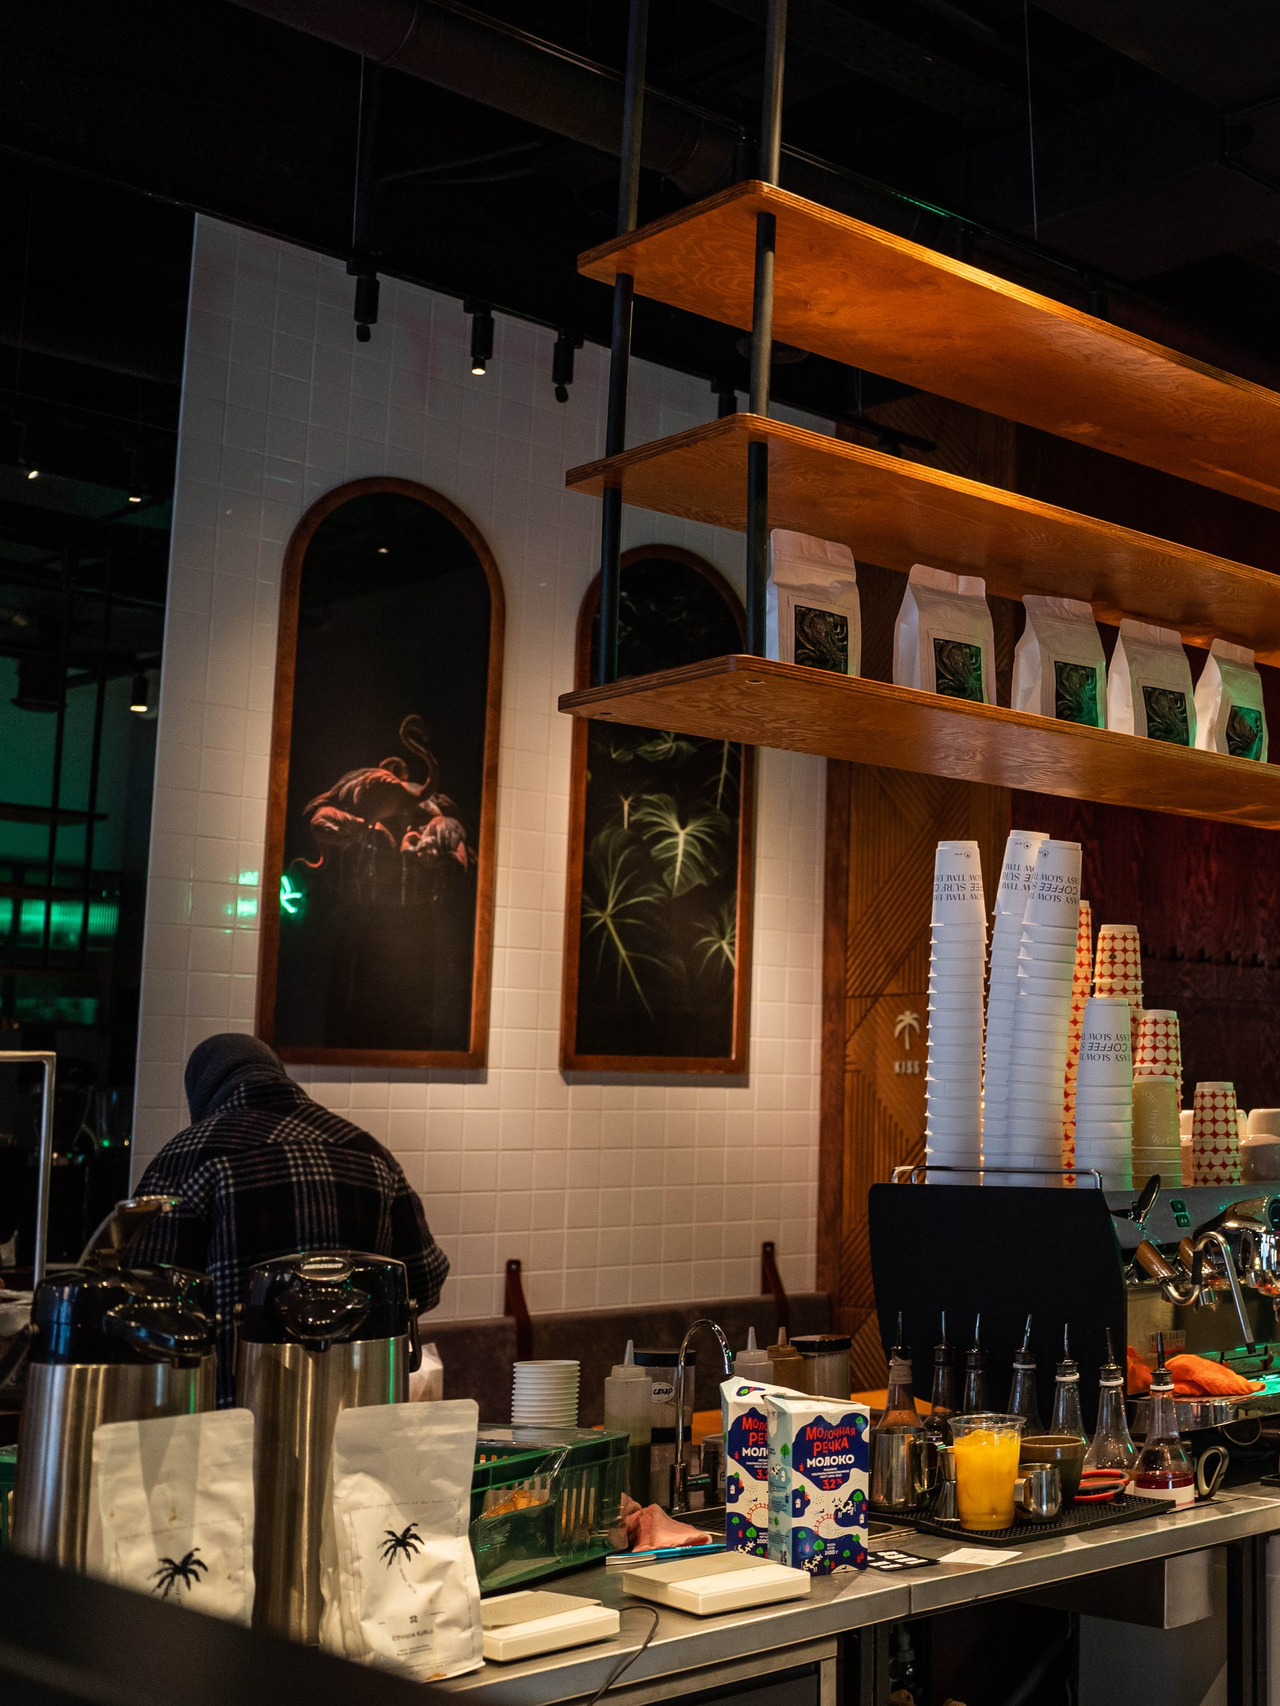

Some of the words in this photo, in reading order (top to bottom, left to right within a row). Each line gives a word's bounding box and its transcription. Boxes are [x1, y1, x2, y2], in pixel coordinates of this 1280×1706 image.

[1040, 873, 1064, 883] SLOW
[941, 883, 966, 892] SURF
[1039, 882, 1078, 895] COFFEE
[1038, 893, 1062, 903] SLOW
[1089, 1033, 1112, 1041] SLOW
[1087, 1042, 1128, 1052] COFFEE
[1087, 1053, 1111, 1061] SLOW
[813, 1436, 849, 1457] РЕЧКА
[742, 1447, 768, 1457] МОЛ
[806, 1454, 855, 1468] МОЛОКО
